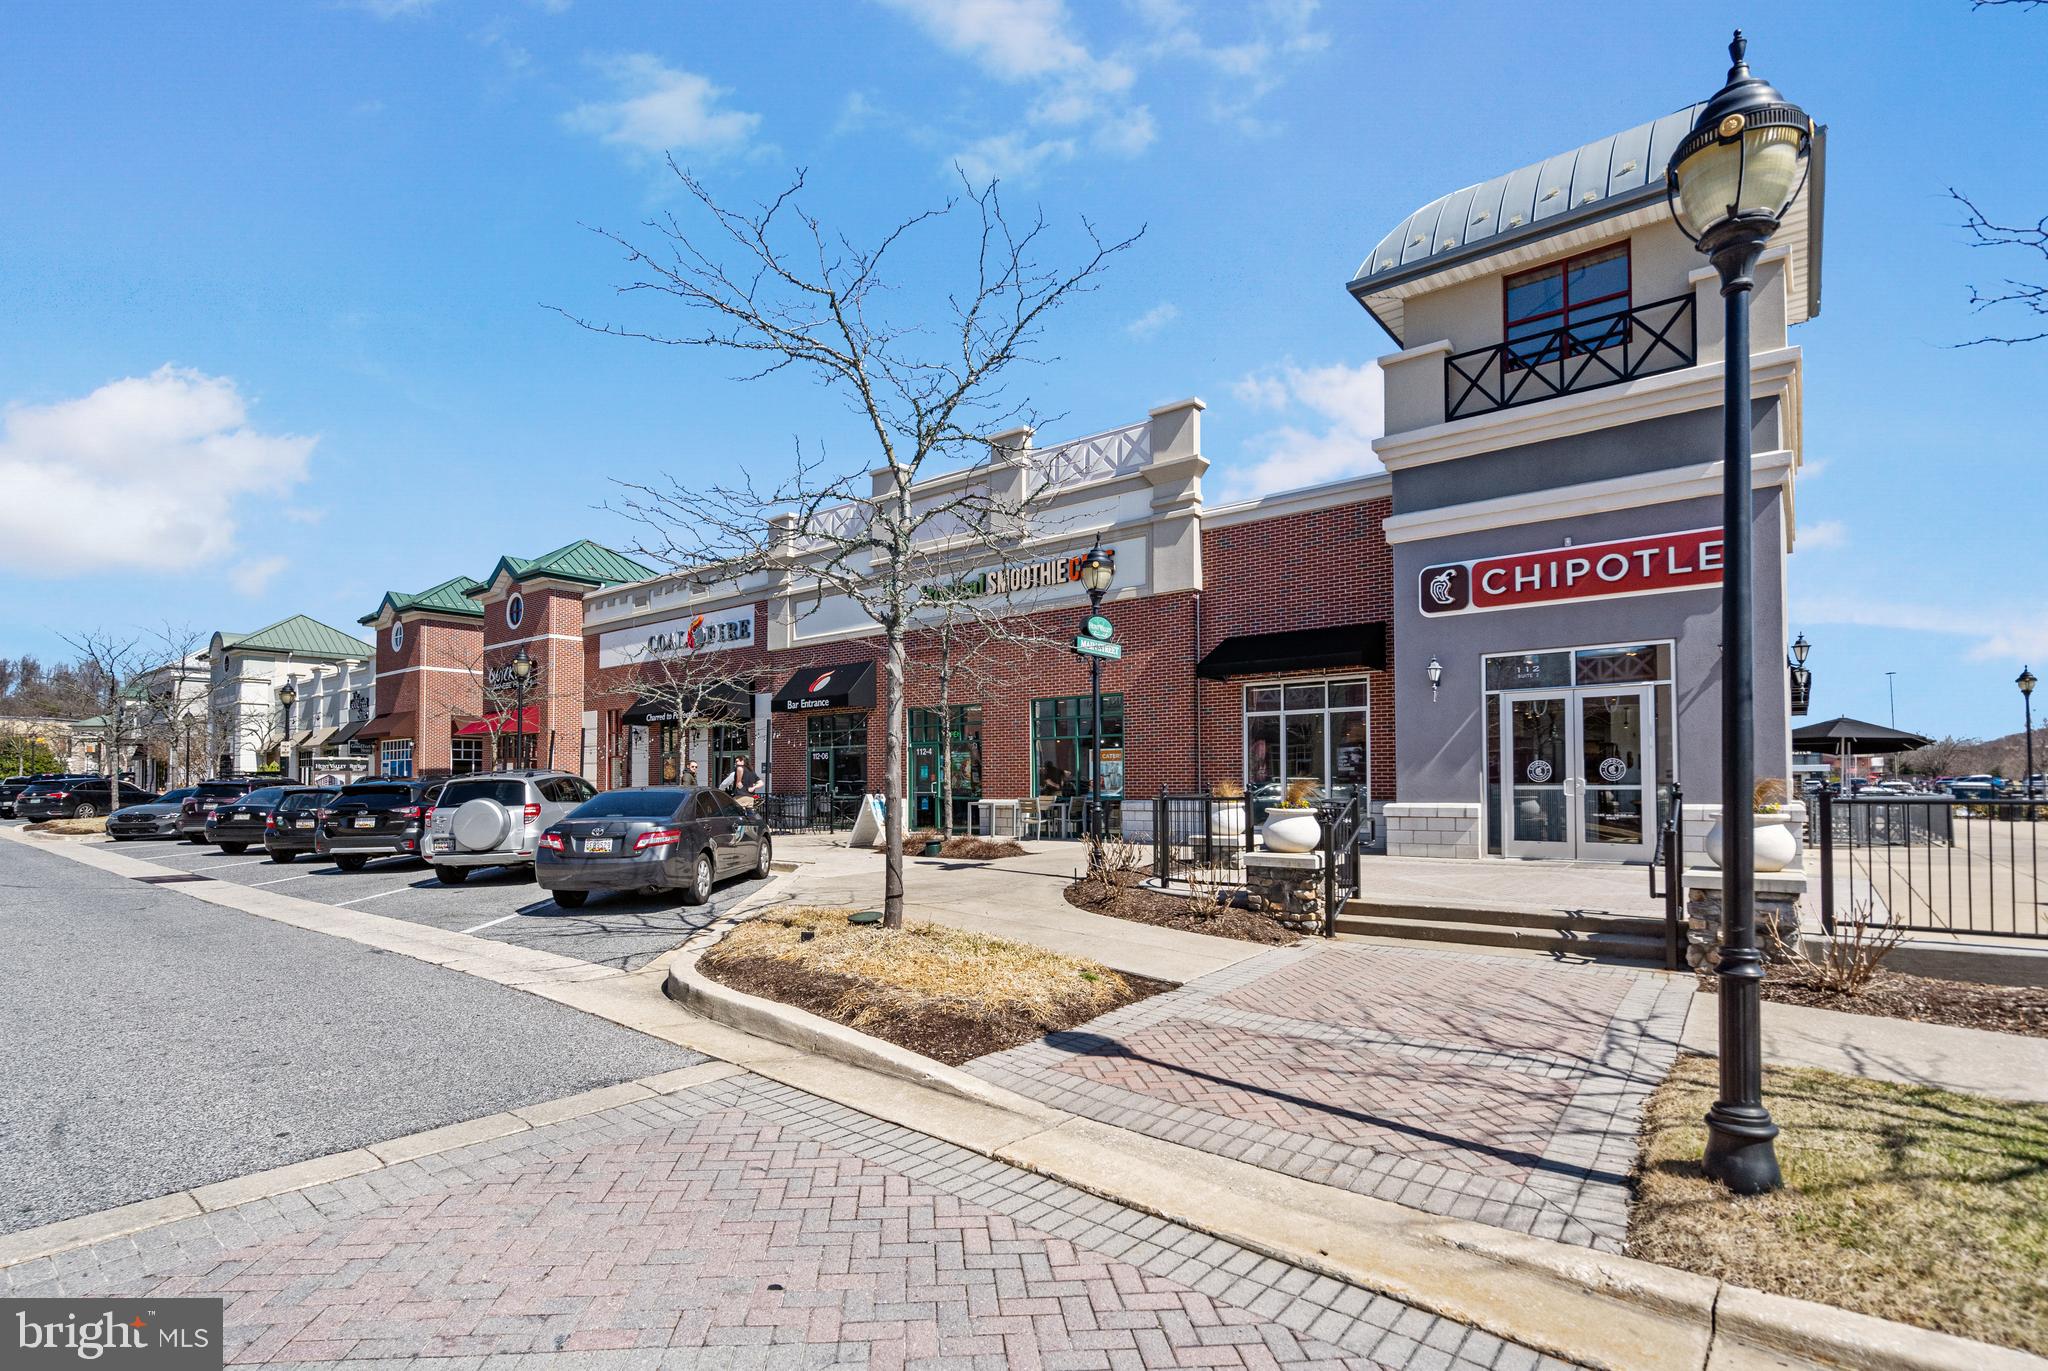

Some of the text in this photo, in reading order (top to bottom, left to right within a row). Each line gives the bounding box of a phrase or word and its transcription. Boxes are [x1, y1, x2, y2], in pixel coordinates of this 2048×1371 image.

[1482, 540, 1723, 595] CHIPOTLE
[987, 558, 1069, 595] SMOOTHIE
[706, 619, 751, 643] FIRE
[787, 699, 829, 709] Bar Entrance
[646, 713, 665, 721] Charred
[812, 752, 829, 760] 112-06
[916, 748, 932, 756] 112-4
